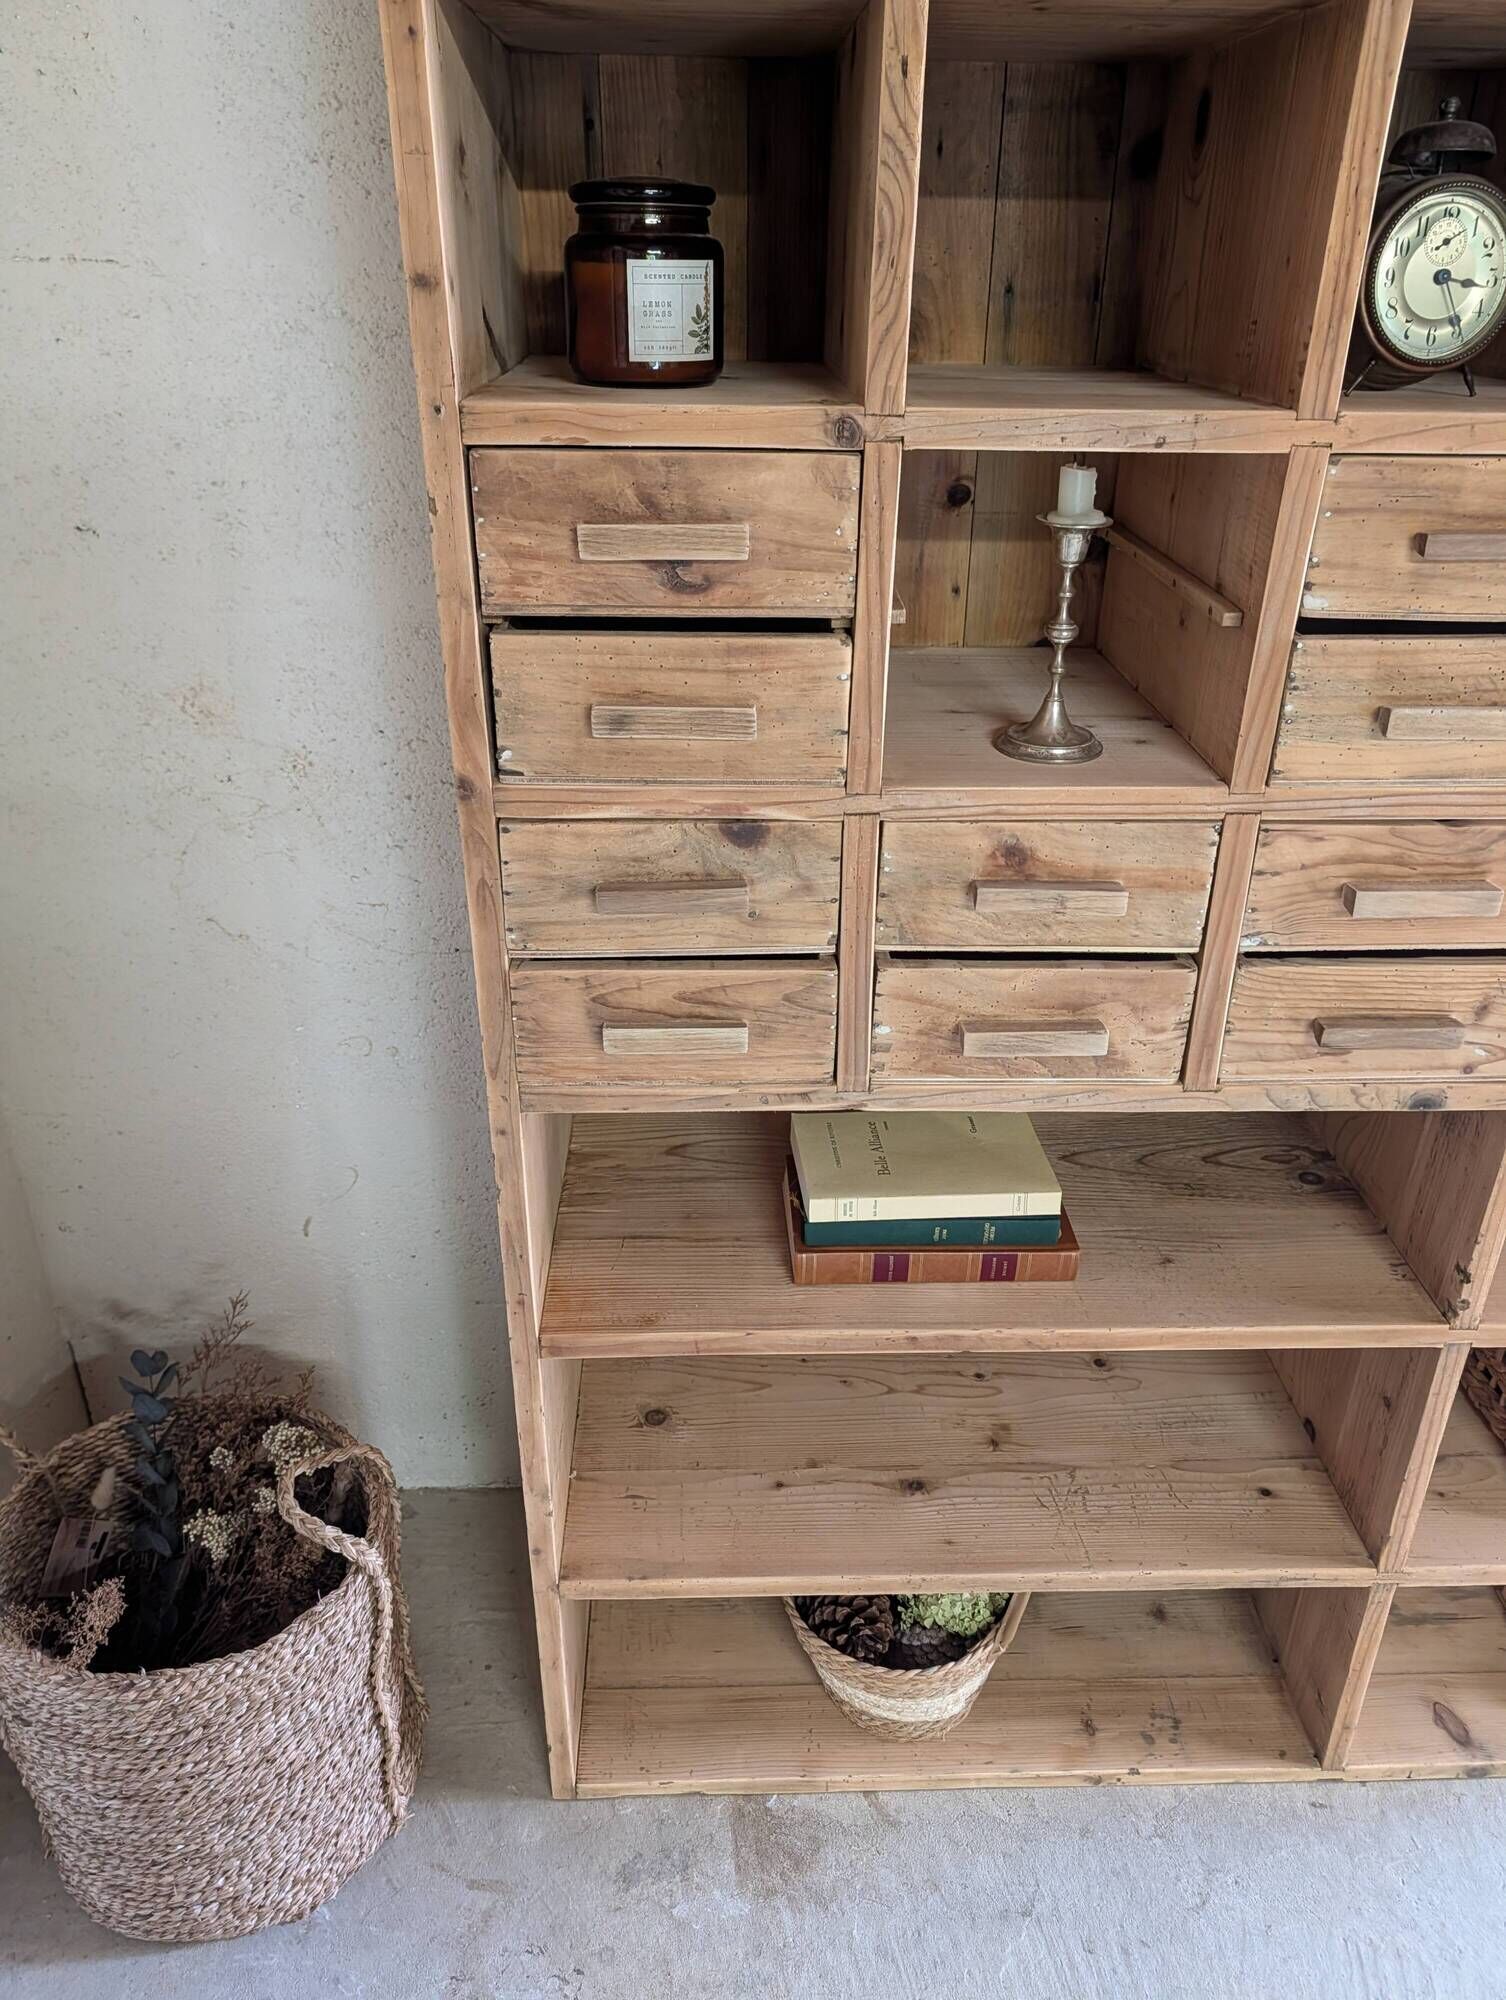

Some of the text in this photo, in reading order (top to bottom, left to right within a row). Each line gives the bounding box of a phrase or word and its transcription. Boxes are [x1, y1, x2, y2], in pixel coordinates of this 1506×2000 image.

[1415, 215, 1430, 239] 11
[1472, 216, 1480, 238] 1
[1393, 236, 1411, 258] 10
[1482, 237, 1495, 259] 2
[1384, 266, 1396, 289] 9
[1486, 268, 1498, 289] 3
[642, 300, 672, 308] LEMON
[642, 310, 673, 318] GRASS
[1385, 296, 1398, 320] 8
[1472, 298, 1484, 320] 4
[1404, 318, 1414, 340] 7
[1425, 325, 1437, 347] 6
[867, 1121, 891, 1176] Belle Alliance
